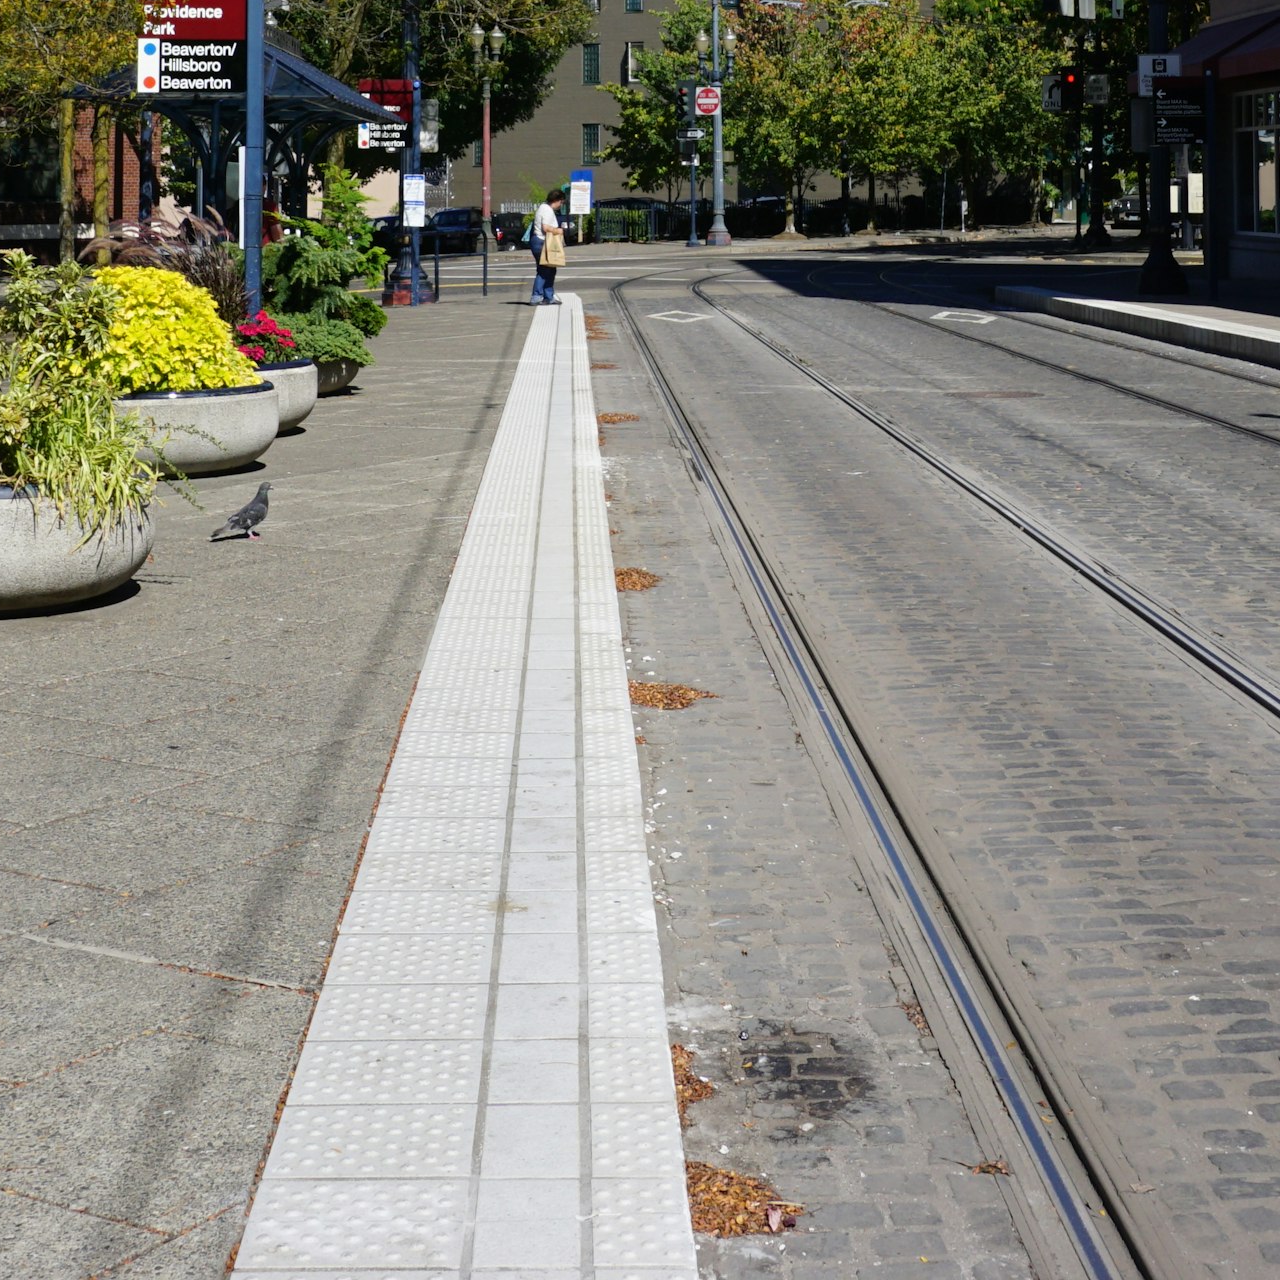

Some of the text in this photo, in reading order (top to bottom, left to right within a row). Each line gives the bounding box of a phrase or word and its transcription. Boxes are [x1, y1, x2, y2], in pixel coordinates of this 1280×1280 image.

[143, 21, 176, 35] Park
[161, 42, 237, 56] Beaverton/
[161, 58, 222, 72] Hillsboro
[160, 75, 232, 89] Beaverton
